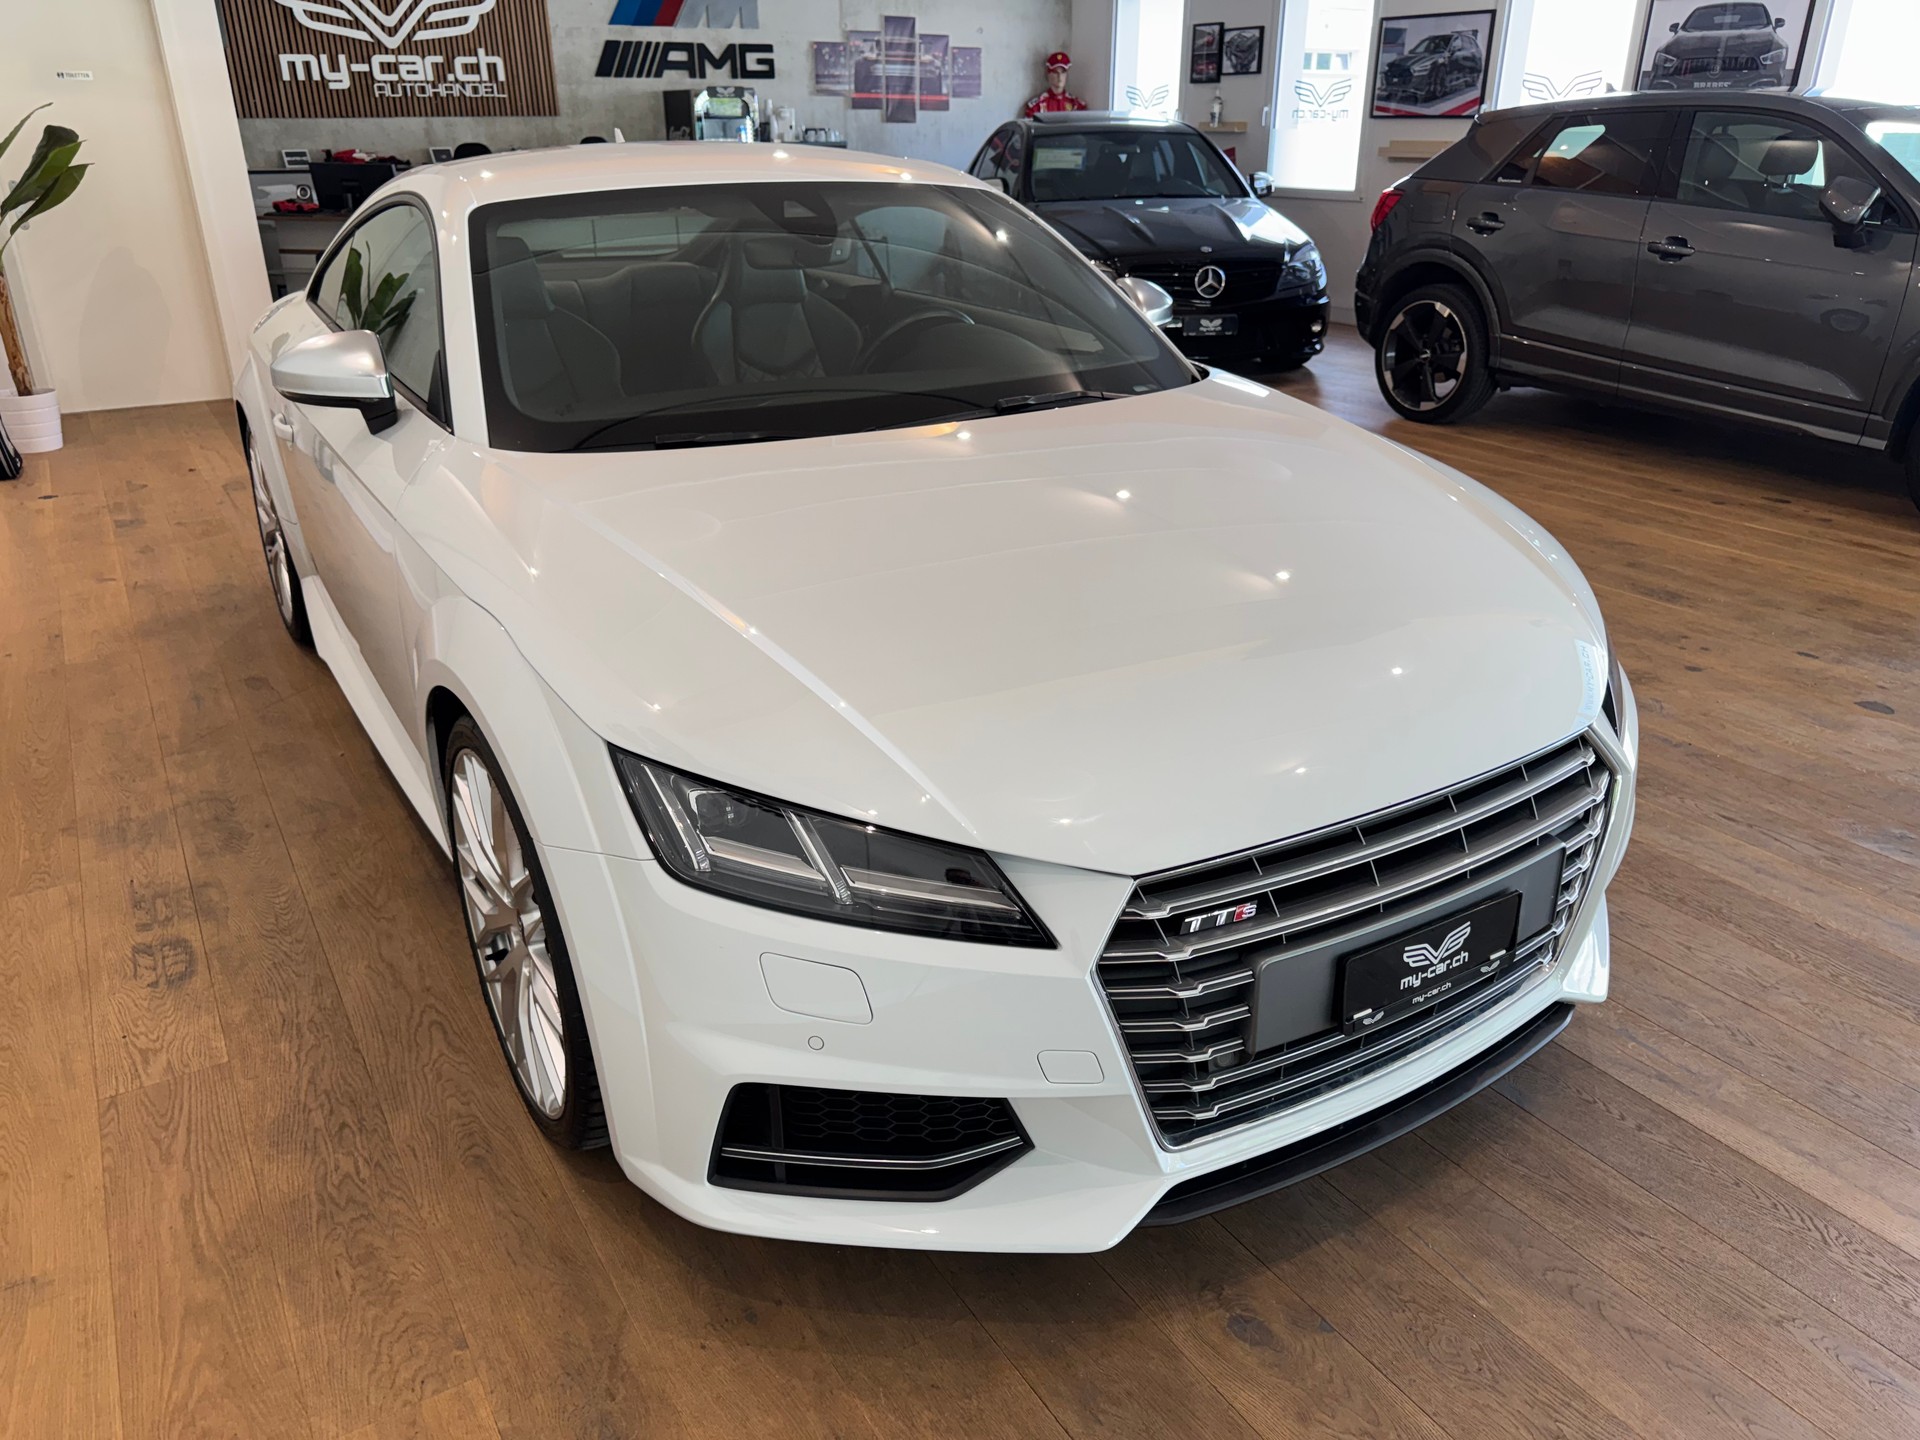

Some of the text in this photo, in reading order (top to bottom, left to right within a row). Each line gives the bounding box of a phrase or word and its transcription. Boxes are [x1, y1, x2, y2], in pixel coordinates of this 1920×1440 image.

[278, 48, 506, 90] my-car.ch
[373, 83, 508, 98] AUTOHANDEL
[1184, 902, 1258, 933] TTS
[1400, 951, 1469, 990] my-car.ch
[1412, 982, 1452, 1004] my-car.ch
